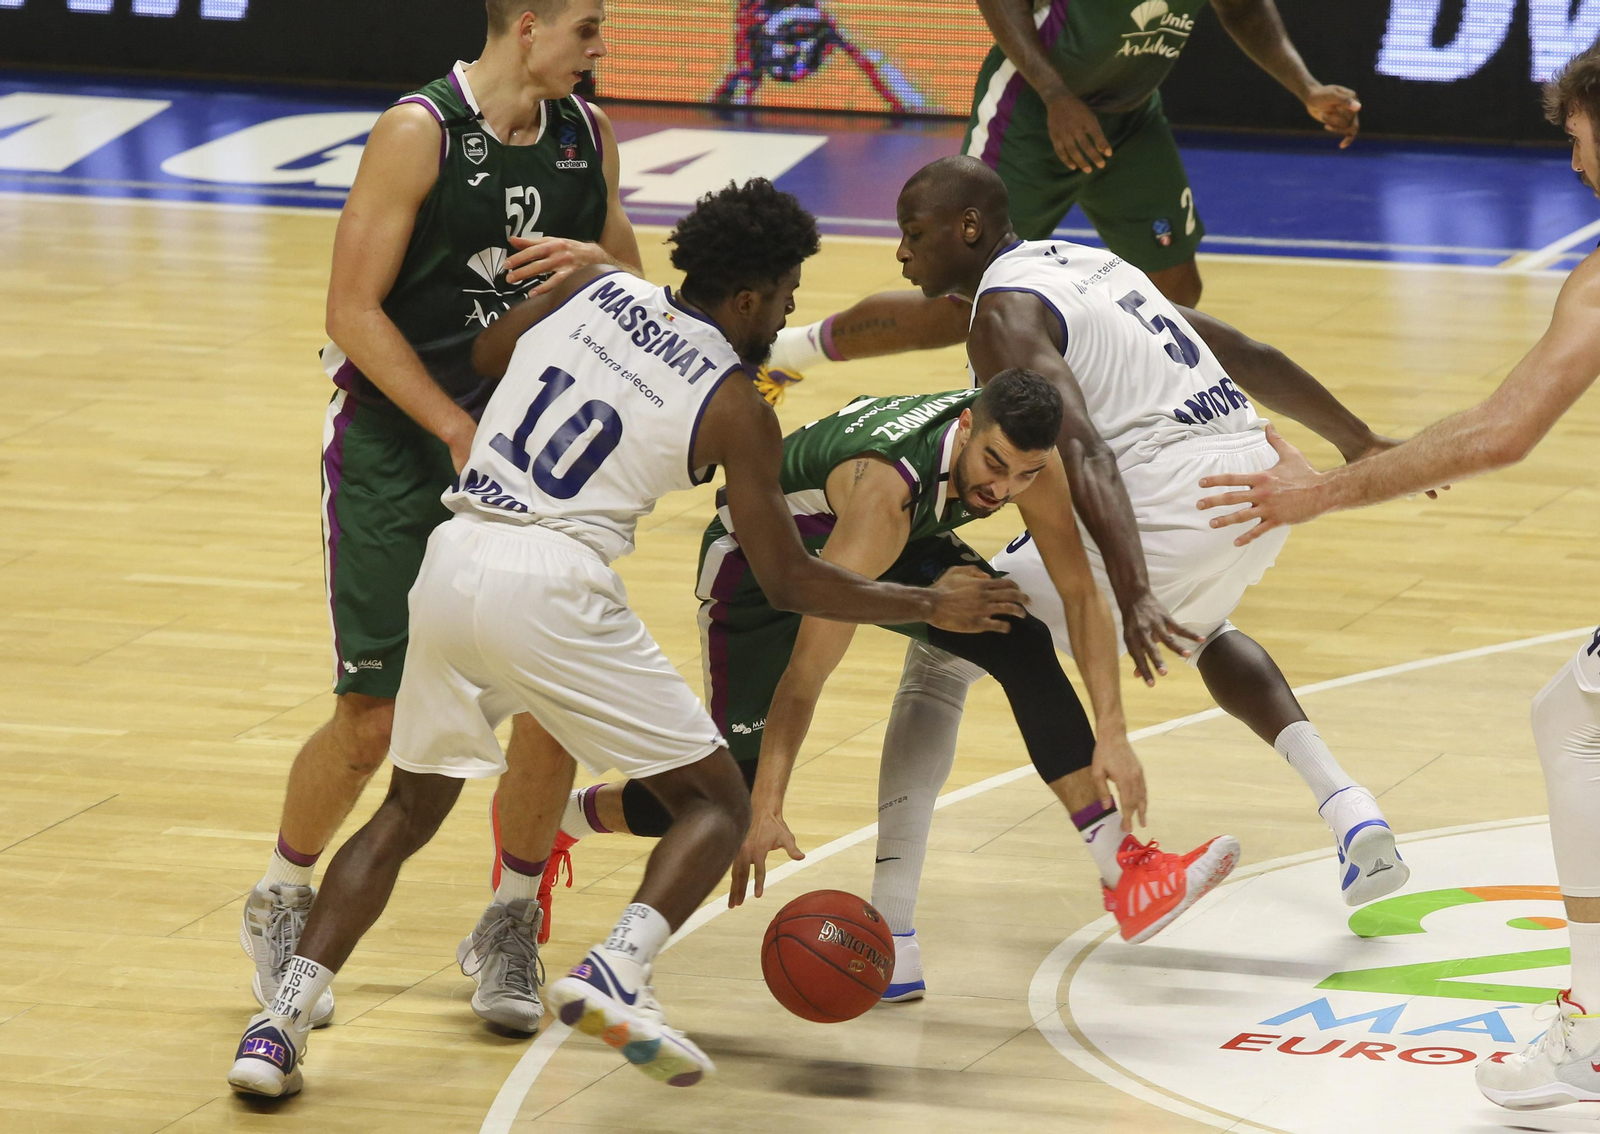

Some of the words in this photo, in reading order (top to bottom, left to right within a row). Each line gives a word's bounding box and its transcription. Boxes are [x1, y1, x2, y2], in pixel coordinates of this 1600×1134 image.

[505, 186, 543, 242] 52
[1181, 187, 1196, 236] 2
[1116, 289, 1200, 369] 5
[582, 335, 622, 372] andorra
[621, 369, 664, 408] telecom
[488, 365, 623, 500] 10
[288, 972, 302, 988] IS
[289, 957, 319, 979] THIS
[280, 985, 300, 1004] MY
[243, 1037, 286, 1067] NIKE
